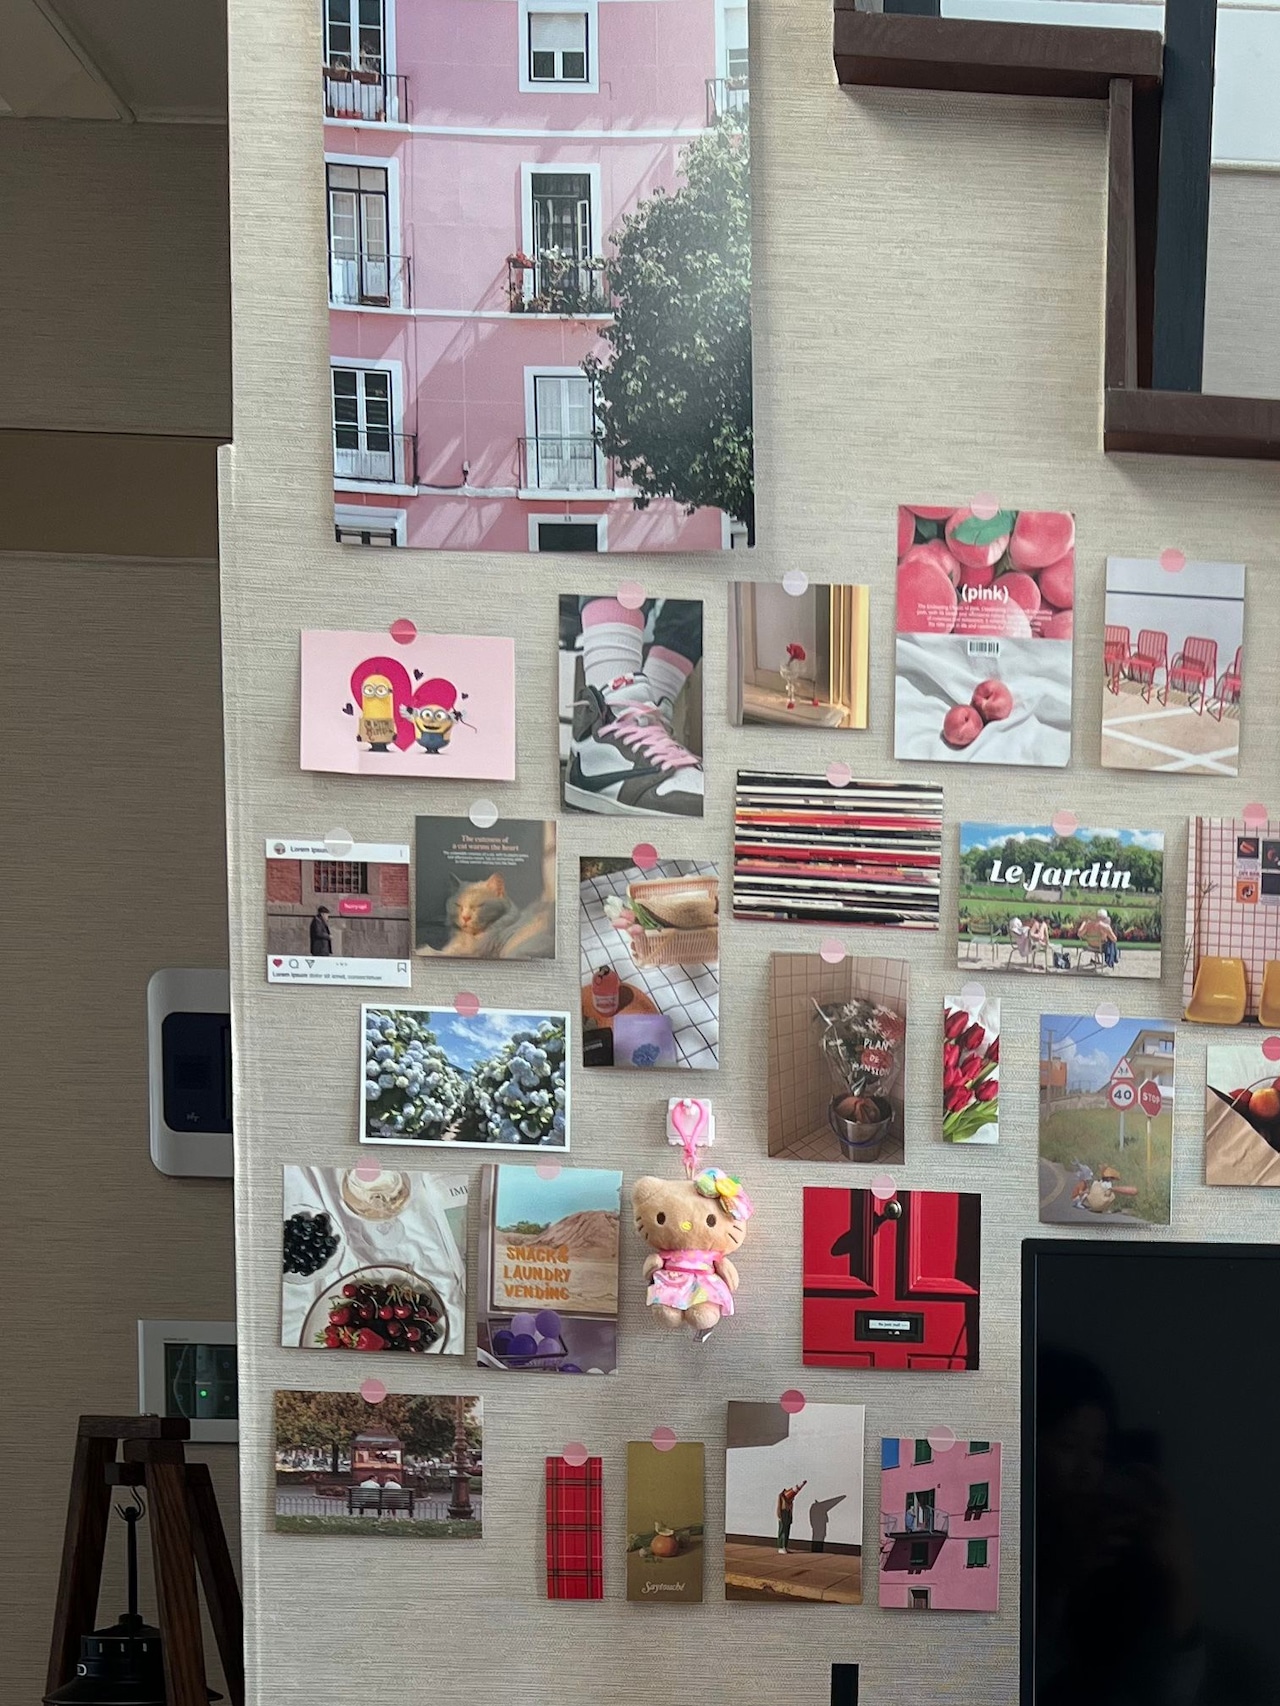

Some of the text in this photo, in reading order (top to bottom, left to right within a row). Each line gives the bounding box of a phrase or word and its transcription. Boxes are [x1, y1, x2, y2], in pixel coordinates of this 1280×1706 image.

[961, 583, 1009, 604] (pink)
[1022, 860, 1132, 892] Jardin
[863, 1037, 890, 1052] PLAN
[1113, 1089, 1132, 1100] 40
[503, 1264, 572, 1283] LAUNDRY
[502, 1282, 571, 1301] VENDING
